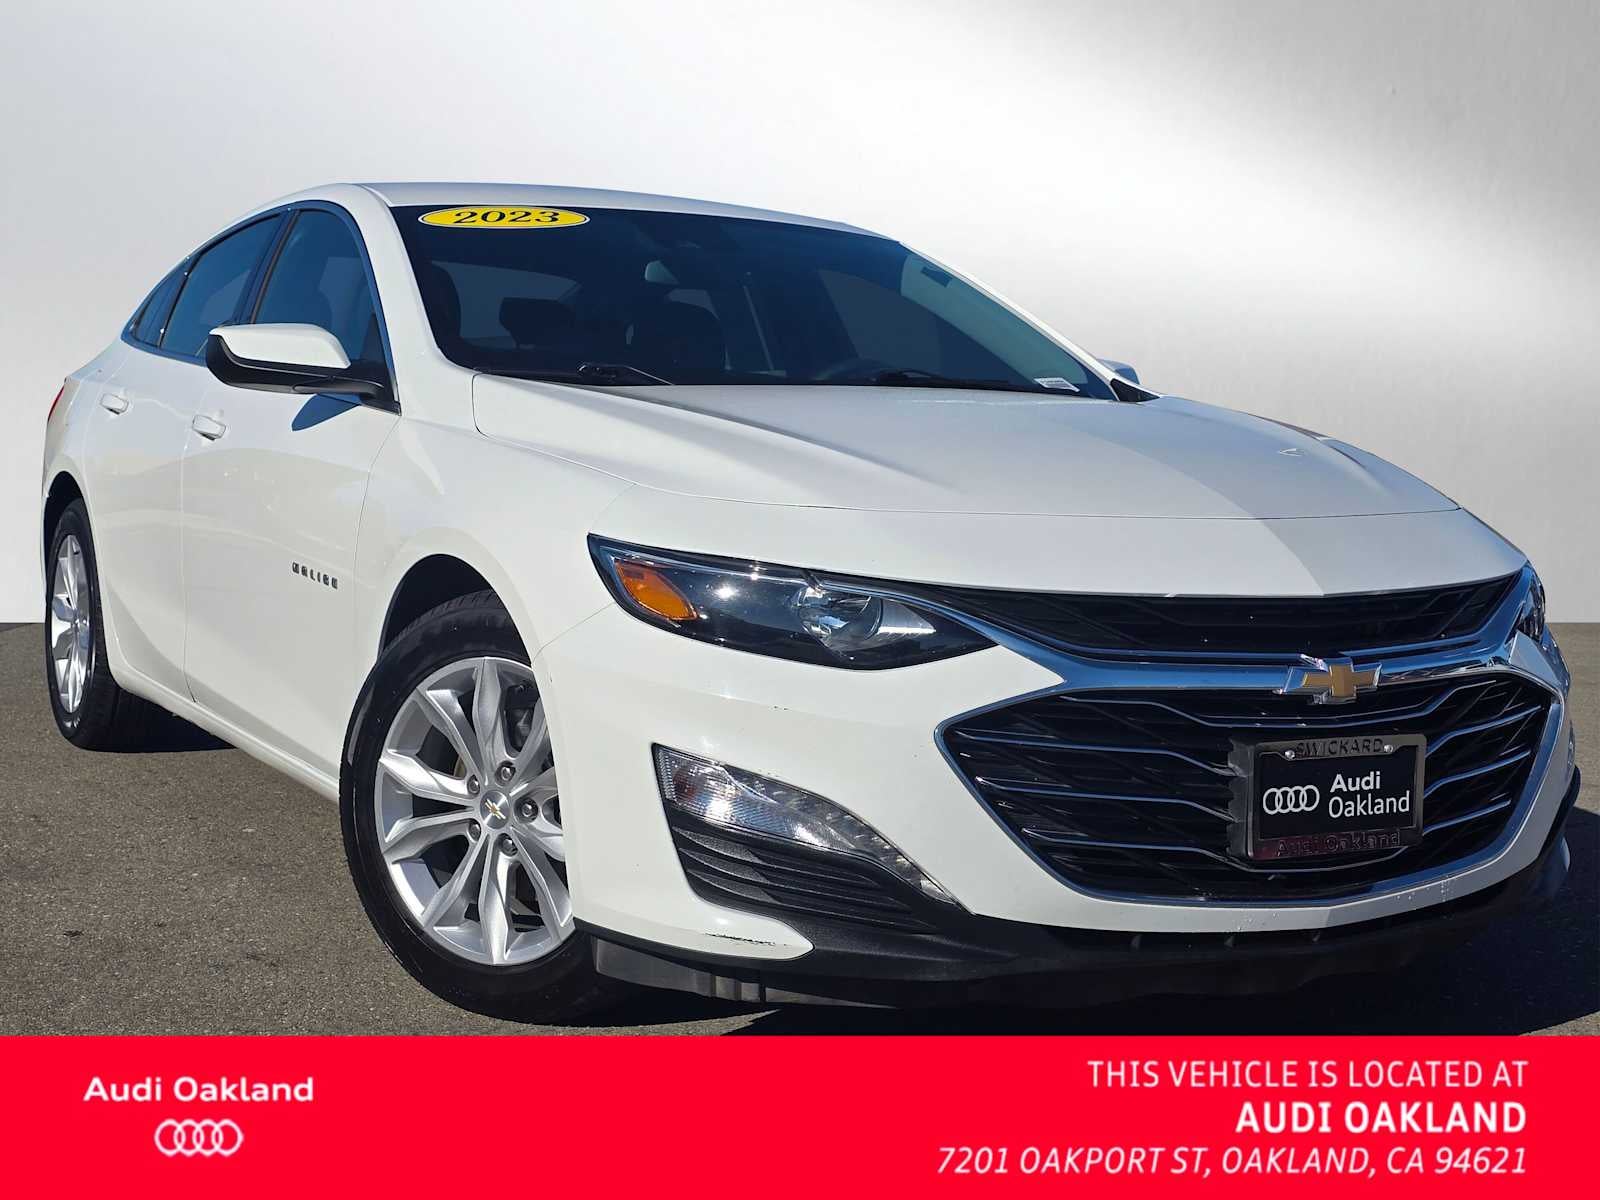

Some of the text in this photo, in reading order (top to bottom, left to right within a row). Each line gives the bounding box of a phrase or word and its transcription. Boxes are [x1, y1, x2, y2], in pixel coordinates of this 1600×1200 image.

[454, 210, 560, 224] 2023
[1296, 738, 1384, 759] SWICKARD
[1329, 771, 1381, 793] Audi
[1328, 790, 1410, 818] Oakland
[1325, 831, 1401, 851] Oakland
